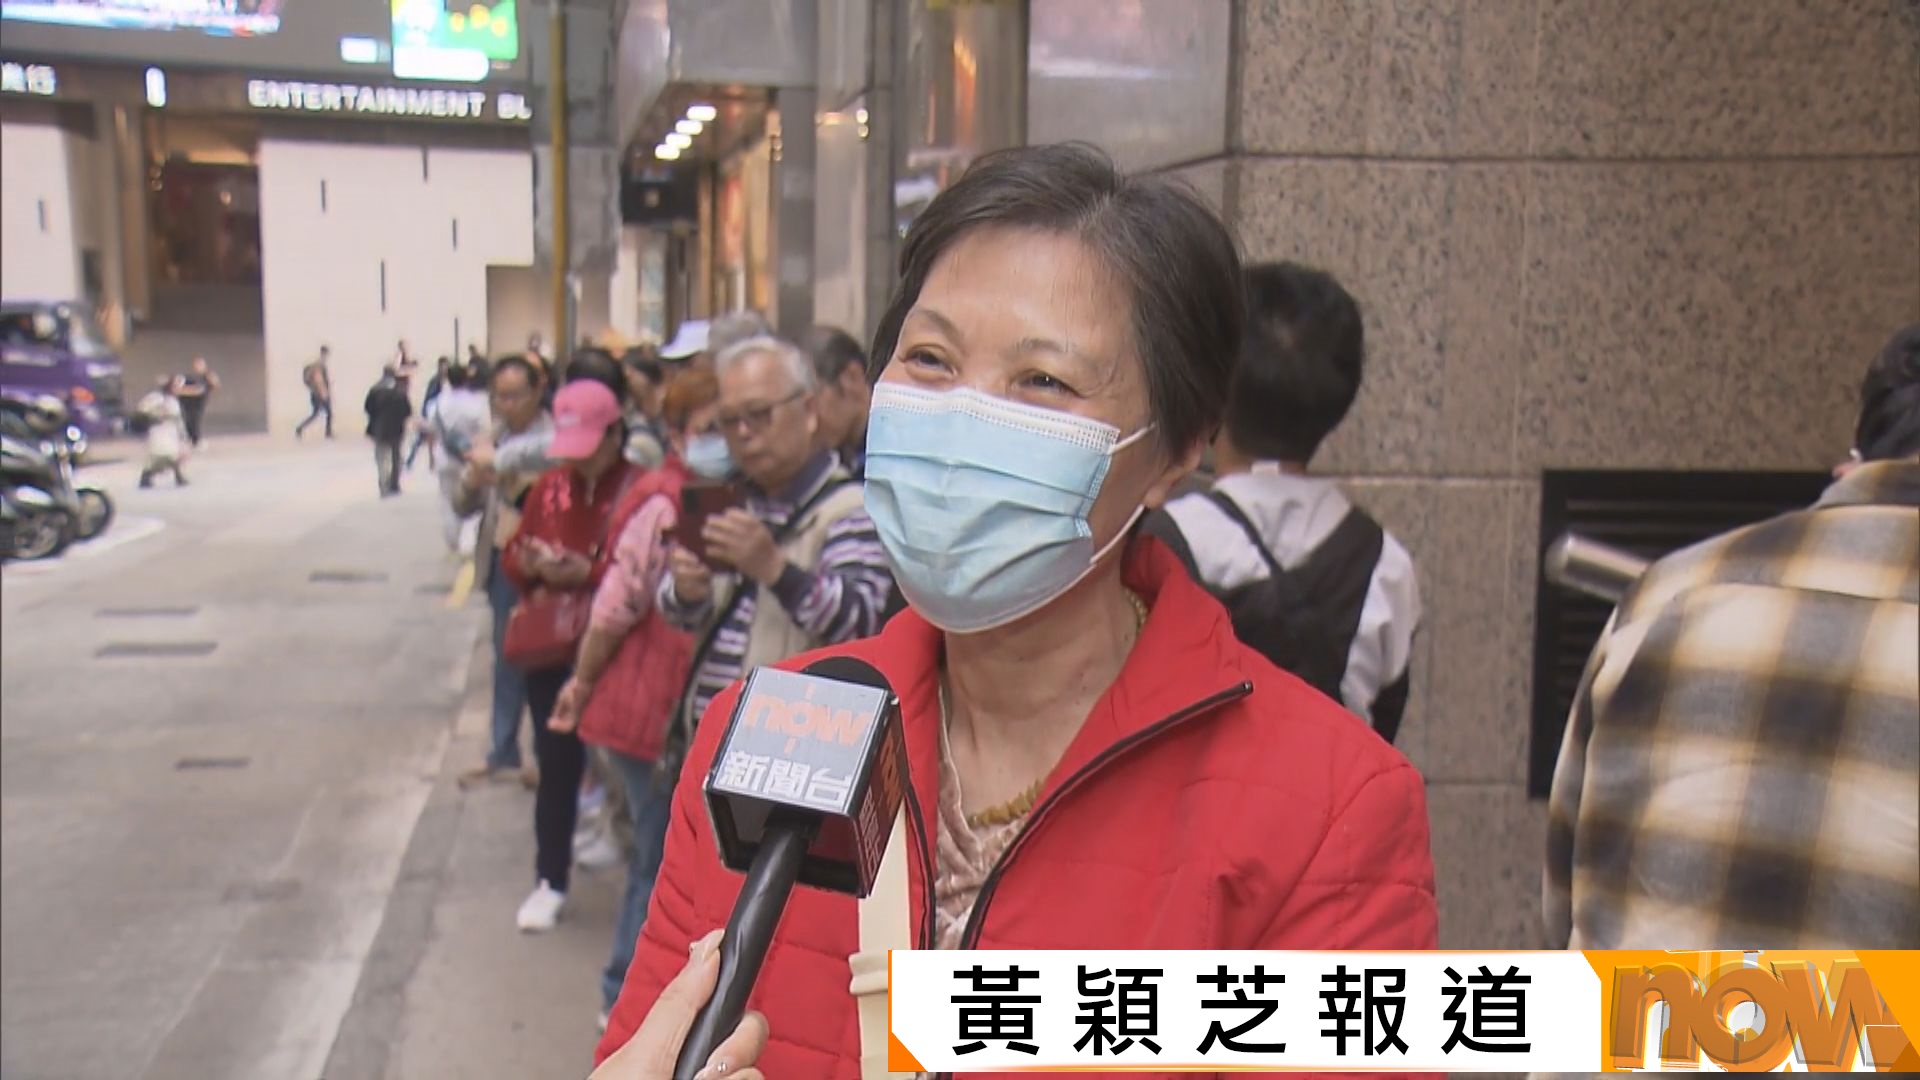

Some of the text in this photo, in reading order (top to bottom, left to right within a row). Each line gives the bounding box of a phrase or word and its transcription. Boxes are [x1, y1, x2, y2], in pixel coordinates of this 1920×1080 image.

[248, 80, 486, 117] ENTERTAINMENT
[719, 750, 852, 807] 新聞台
